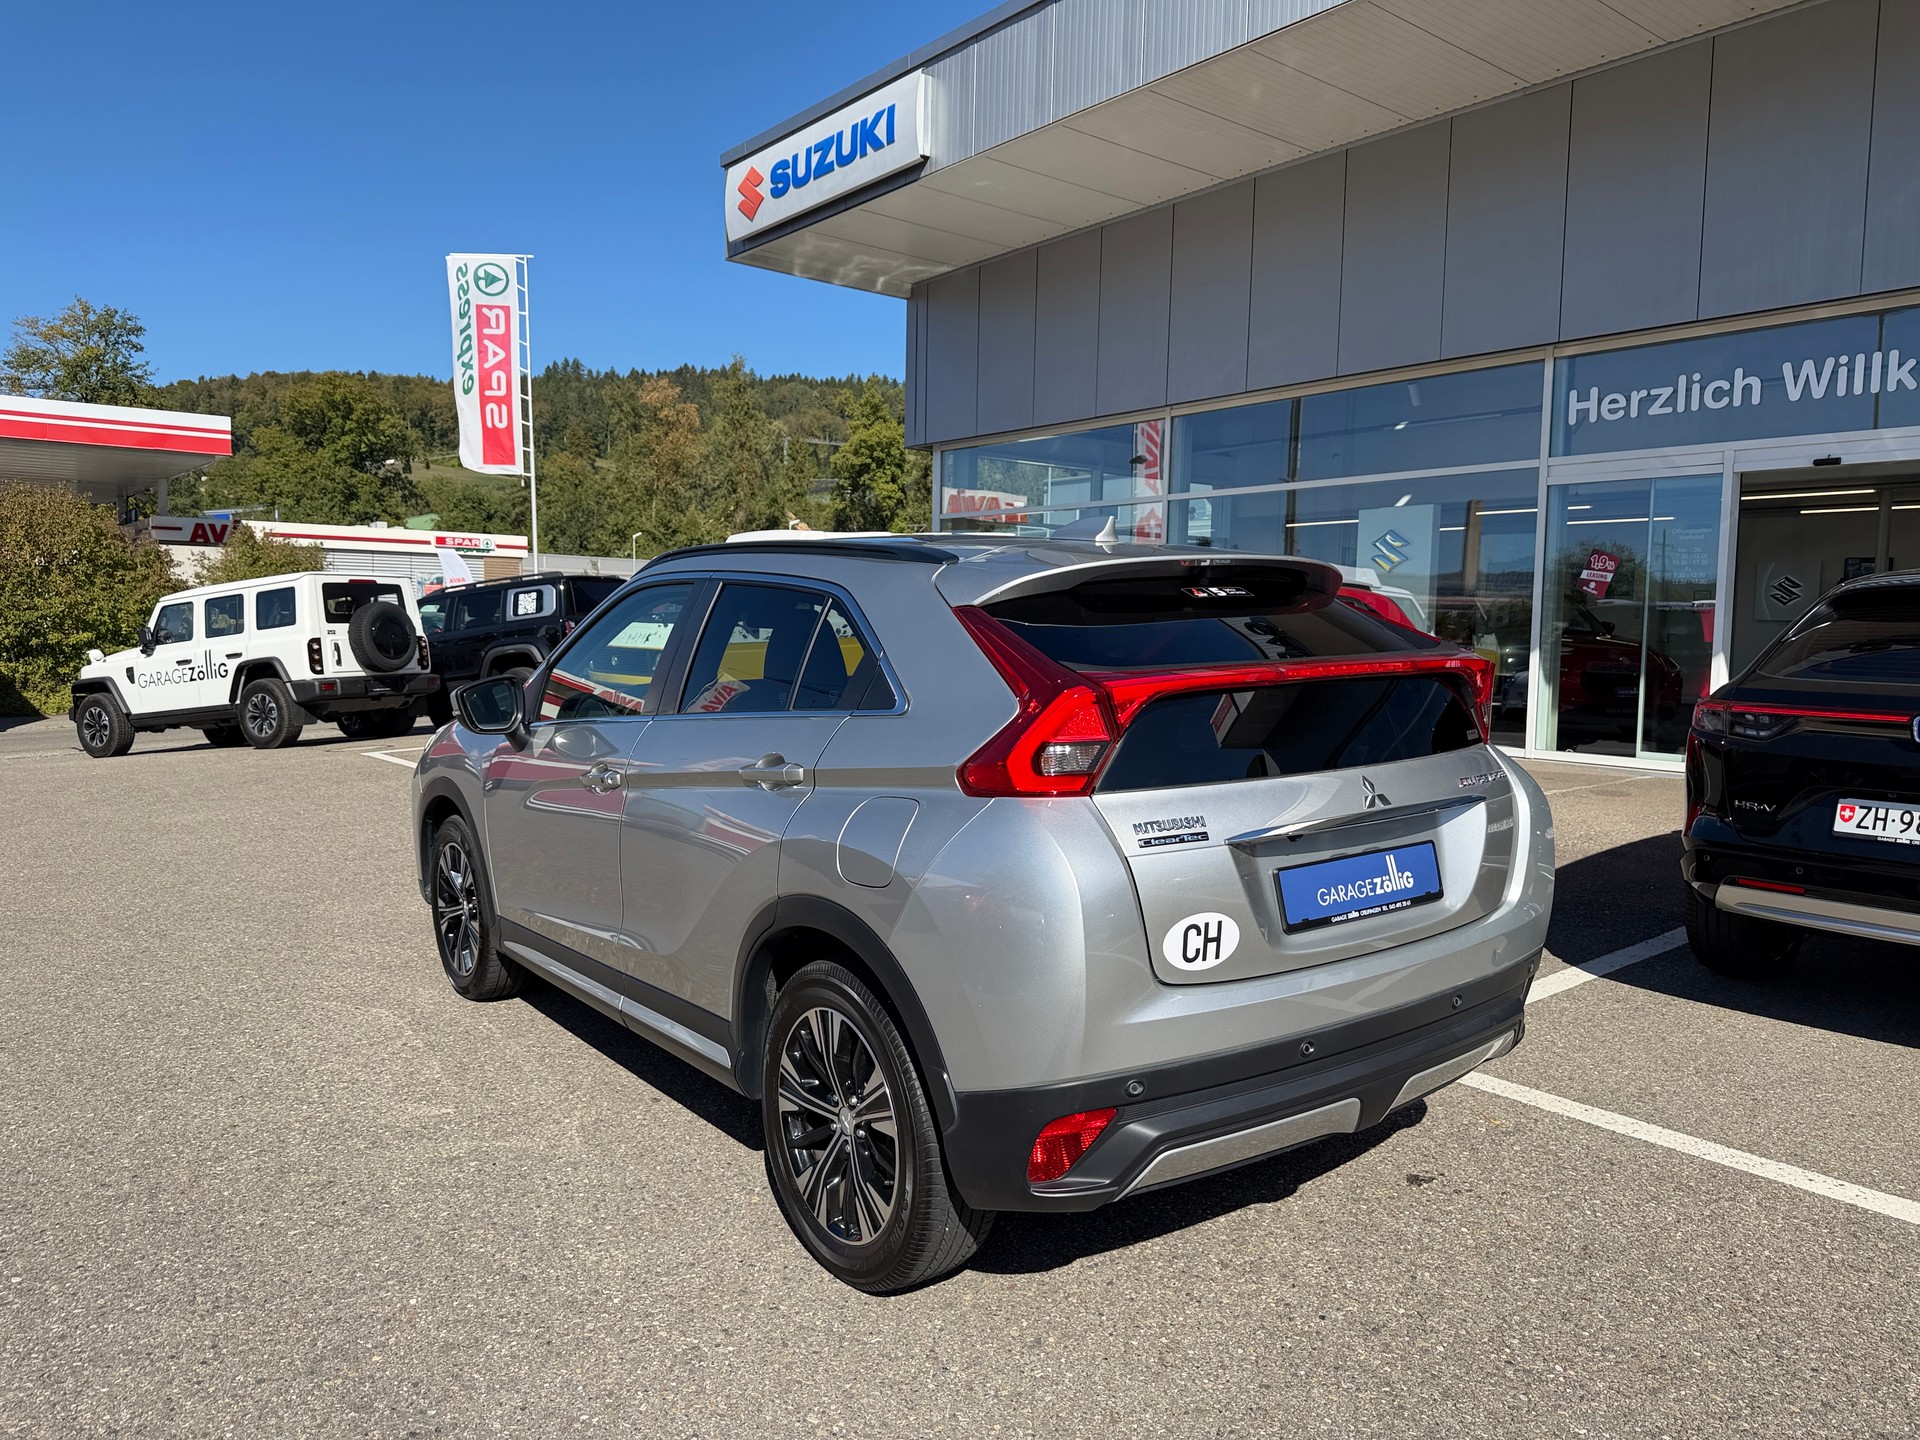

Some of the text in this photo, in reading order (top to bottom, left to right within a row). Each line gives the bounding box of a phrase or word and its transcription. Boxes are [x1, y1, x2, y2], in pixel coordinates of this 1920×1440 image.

[770, 103, 896, 199] SUZUKI
[1568, 367, 1763, 426] Herzlich
[189, 517, 241, 544] AV
[445, 537, 480, 547] SPAR
[1586, 571, 1608, 580] LEASING
[1132, 815, 1207, 835] MITSUBISHI
[1139, 833, 1208, 847] ClearTec
[1182, 920, 1222, 963] CH
